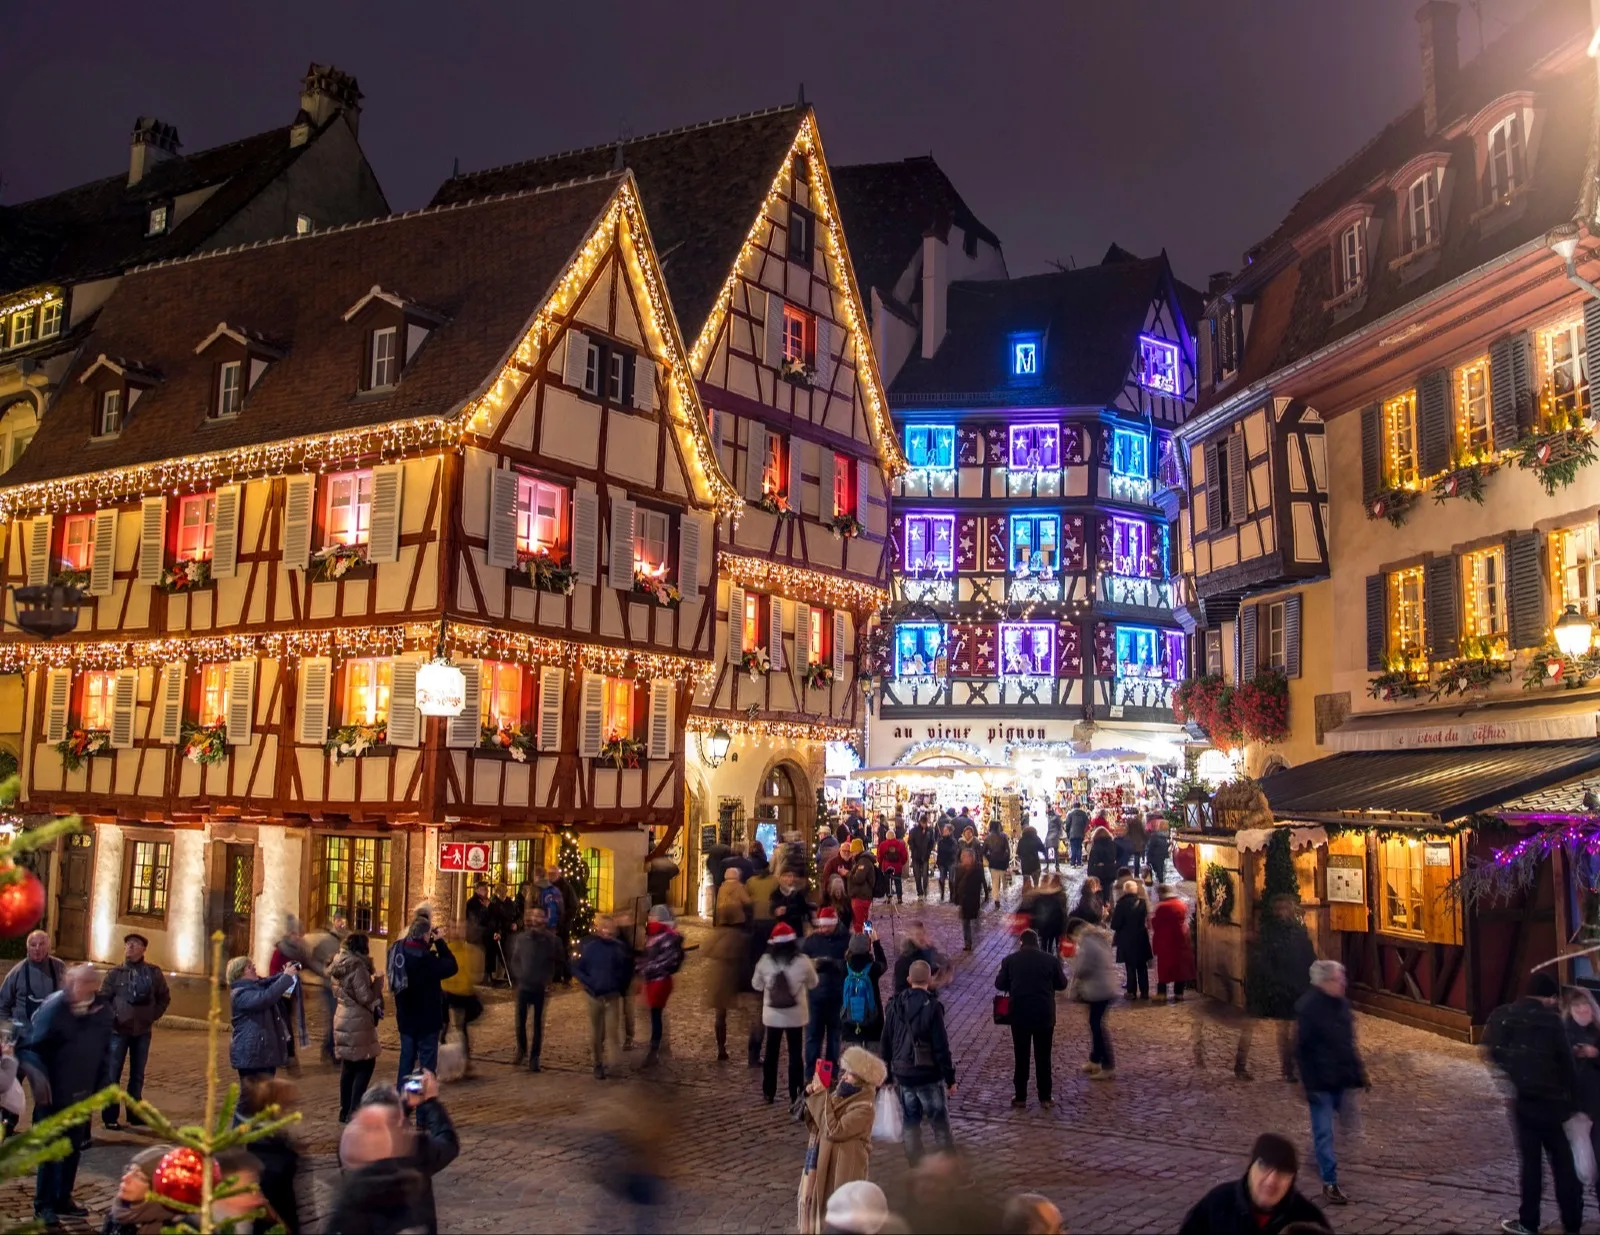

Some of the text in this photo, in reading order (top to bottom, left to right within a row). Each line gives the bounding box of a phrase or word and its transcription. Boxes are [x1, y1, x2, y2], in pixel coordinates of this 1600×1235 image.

[894, 723, 1046, 744] au vieux pignon
[1412, 730, 1442, 744] istrot
[1444, 728, 1459, 742] du
